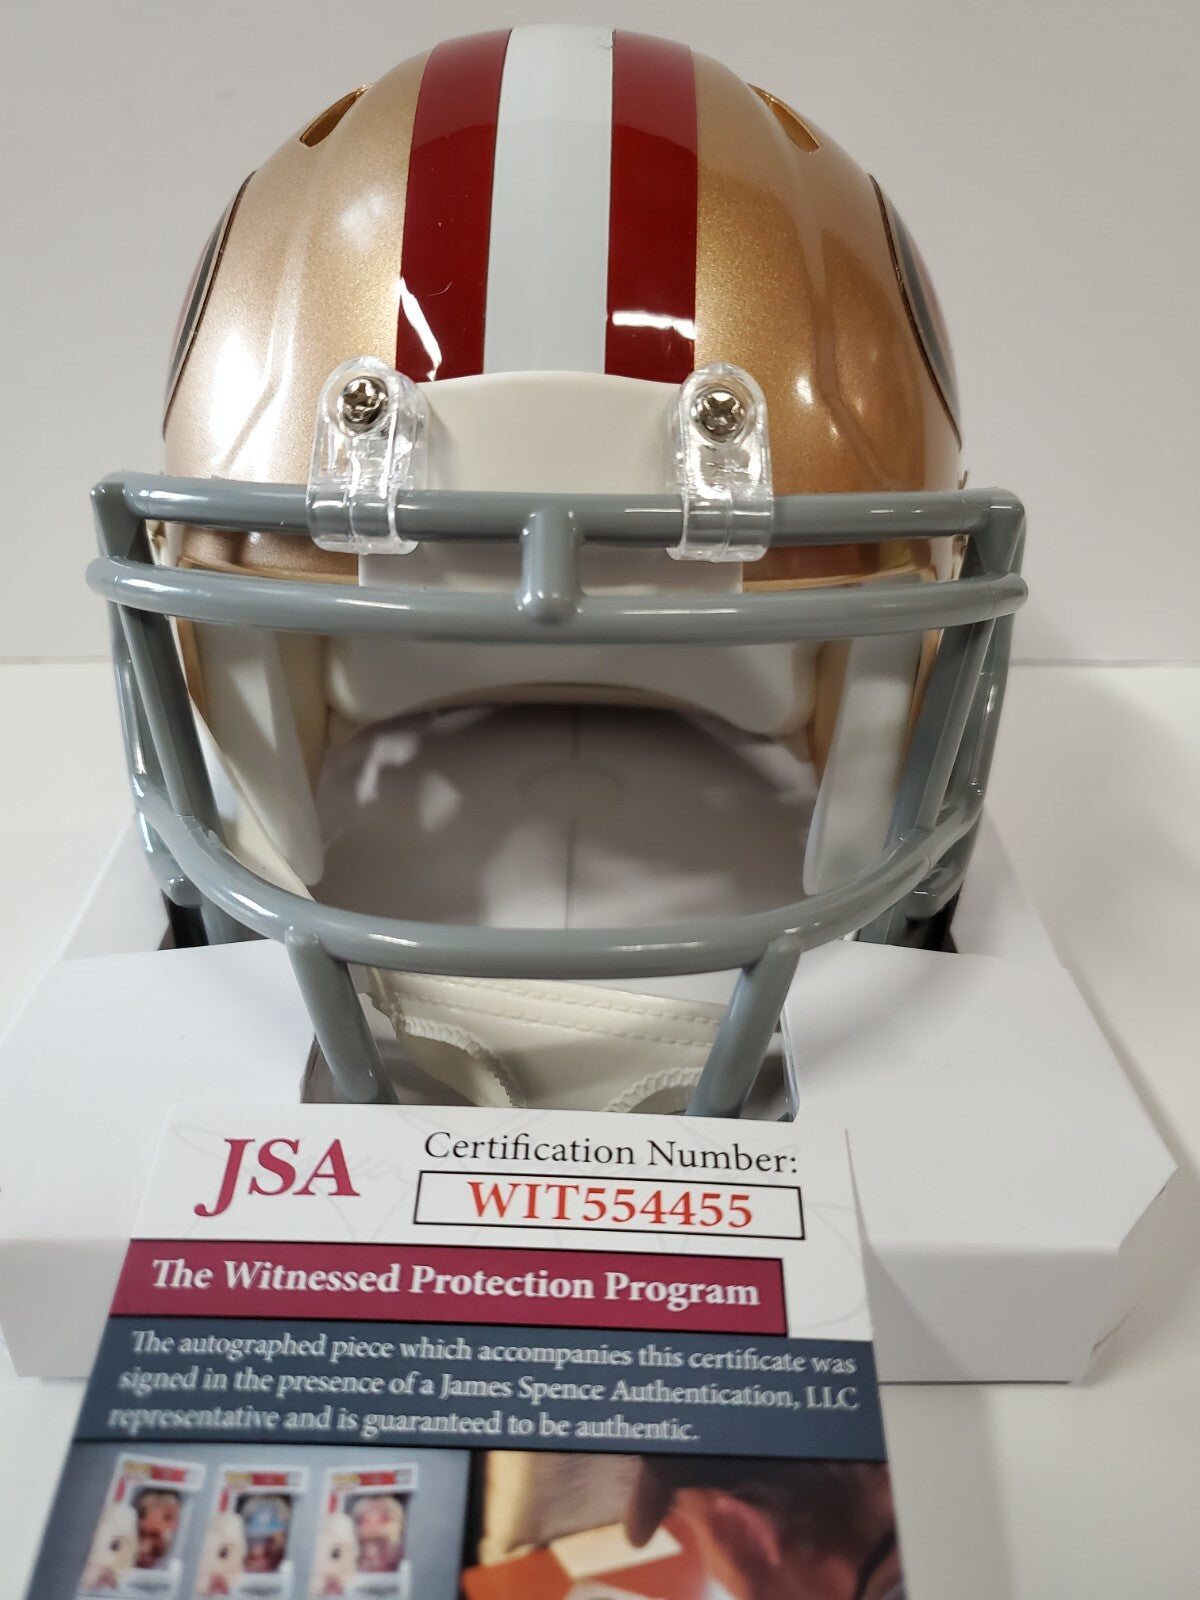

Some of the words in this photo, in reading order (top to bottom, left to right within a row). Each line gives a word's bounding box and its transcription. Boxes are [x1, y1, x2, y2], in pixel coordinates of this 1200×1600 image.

[425, 1131, 635, 1165] Certification
[648, 1139, 798, 1174] Number:
[194, 1138, 360, 1217] JSA
[467, 1181, 753, 1229] WIT554455
[152, 1259, 213, 1289] The
[224, 1260, 400, 1293] Witnessed
[409, 1265, 595, 1300] Protection
[604, 1272, 760, 1312] Program
[131, 1330, 174, 1352] The
[179, 1332, 326, 1362] autographed
[331, 1336, 394, 1363] piece
[399, 1337, 473, 1361] which
[477, 1343, 633, 1370] accompanies
[638, 1345, 682, 1368] this
[688, 1348, 806, 1373] certificate
[811, 1357, 856, 1375] was
[117, 1366, 198, 1397] signed
[203, 1367, 228, 1390] in
[233, 1367, 274, 1392] the
[276, 1374, 384, 1399] presence
[387, 1371, 420, 1395] of
[420, 1379, 434, 1395] a
[439, 1373, 512, 1400] James
[518, 1375, 605, 1403] Spence
[610, 1379, 800, 1410] Authentication,
[804, 1385, 860, 1410] LLC
[107, 1405, 280, 1437] representative
[283, 1405, 332, 1430] and
[337, 1407, 357, 1431] is
[361, 1411, 500, 1440] guaranteed
[507, 1415, 534, 1437] to
[539, 1413, 569, 1437] be
[575, 1417, 699, 1441] authentic.
